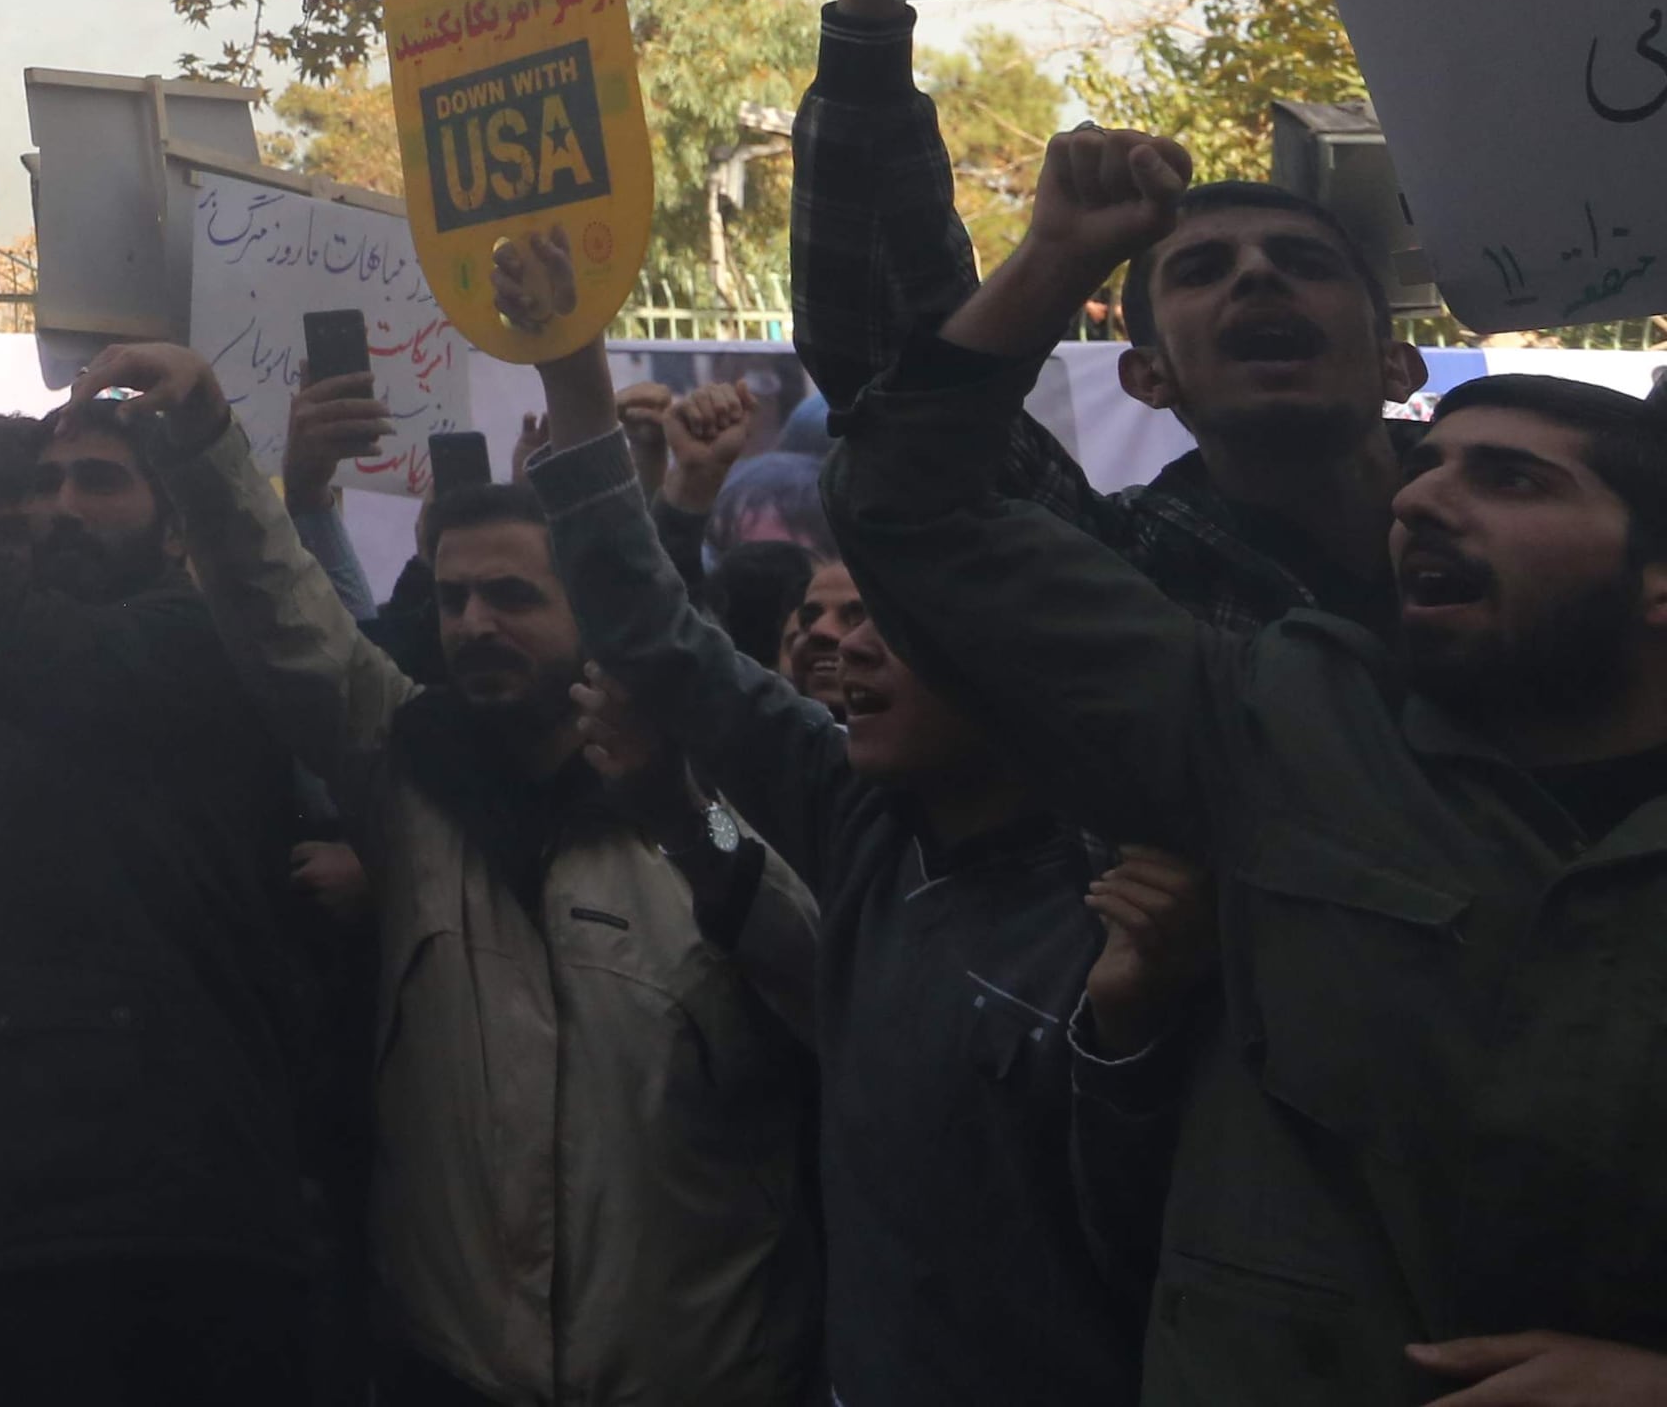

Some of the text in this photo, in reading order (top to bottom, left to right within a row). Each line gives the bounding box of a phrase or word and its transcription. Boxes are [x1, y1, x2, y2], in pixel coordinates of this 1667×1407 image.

[394, 9, 464, 66] بکشید
[435, 56, 578, 121] DOWN WITH
[439, 94, 594, 212] USA
